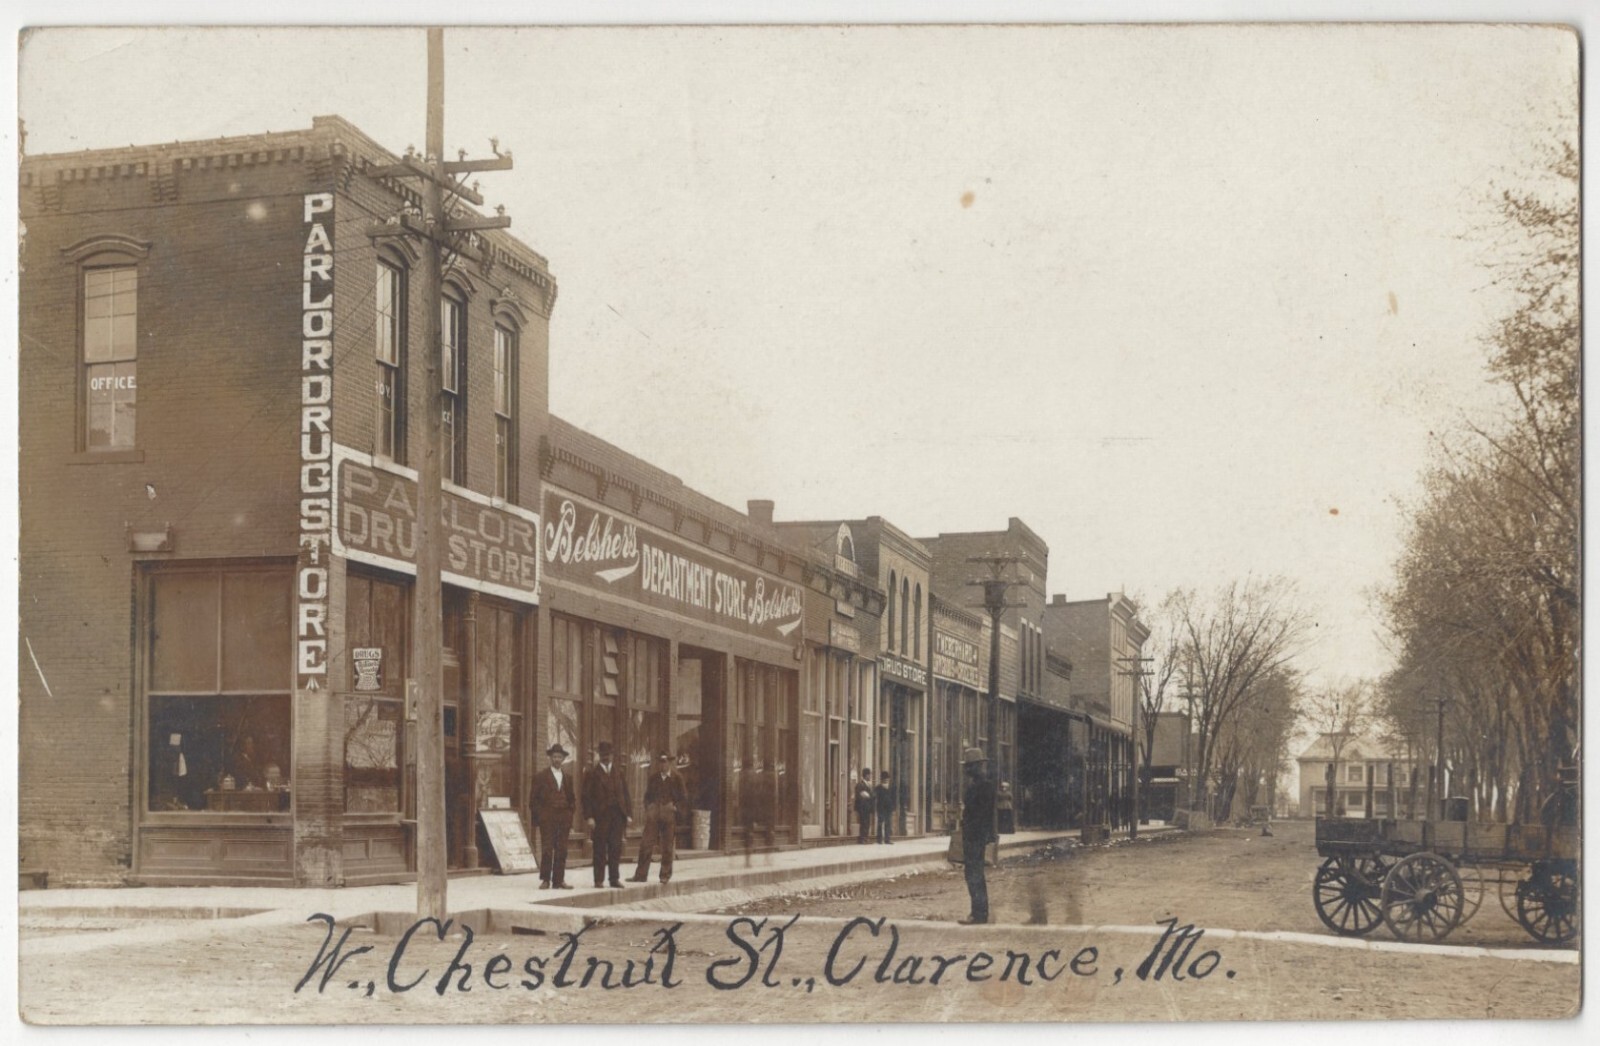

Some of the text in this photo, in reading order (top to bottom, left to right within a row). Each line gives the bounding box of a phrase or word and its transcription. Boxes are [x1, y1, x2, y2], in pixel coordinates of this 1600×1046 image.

[90, 376, 137, 390] OFFICE
[299, 192, 334, 674] PARLOR DRUG STORE
[343, 501, 536, 587] DRU STORE
[642, 542, 713, 609] DEPARTMENT
[714, 570, 747, 621] STORE
[355, 650, 380, 658] DRUGS
[902, 664, 927, 686] STORE
